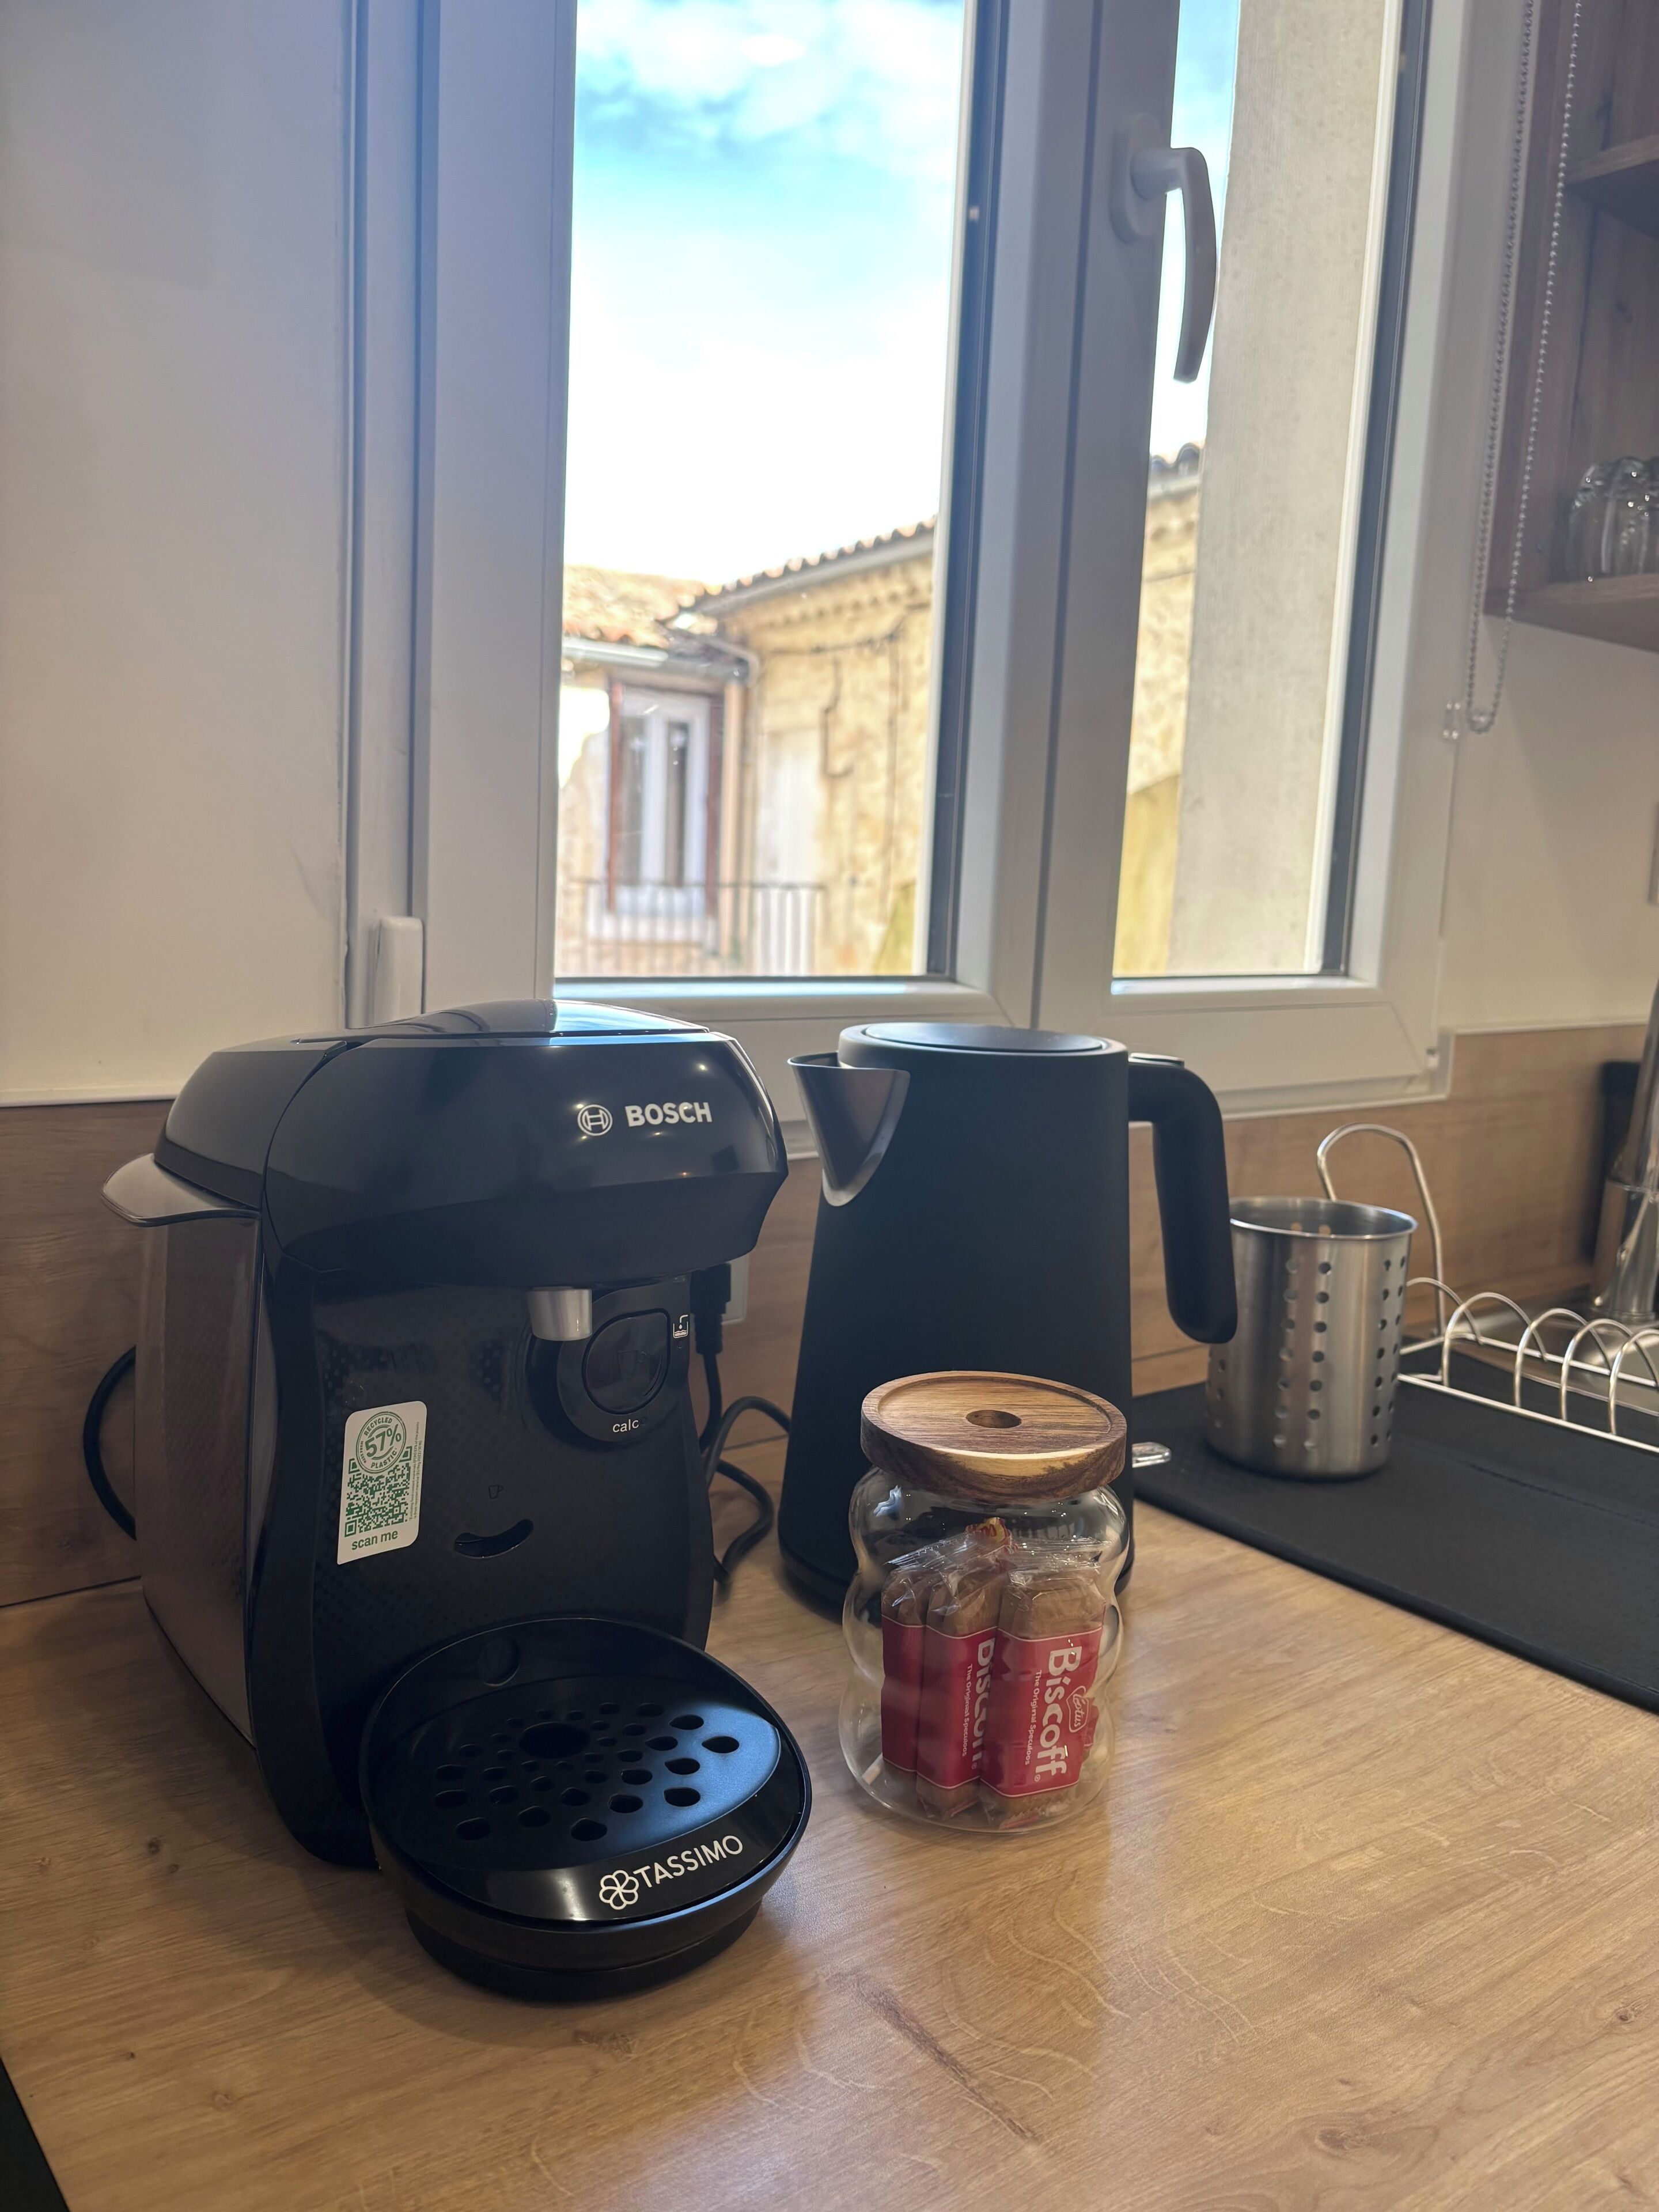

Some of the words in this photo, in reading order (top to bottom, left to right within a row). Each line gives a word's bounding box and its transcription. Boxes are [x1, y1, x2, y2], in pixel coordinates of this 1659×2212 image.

[624, 1102, 712, 1127] BOSCH
[364, 1417, 392, 1436] RECYCLED
[365, 1424, 402, 1457] 57%
[612, 1419, 639, 1433] calc
[351, 1535, 377, 1550] scan
[381, 1530, 398, 1543] me
[964, 1681, 972, 1717] Original
[1031, 1688, 1040, 1722] Original
[962, 1718, 970, 1757] Speculoos
[1025, 1724, 1036, 1765] Speculoos
[632, 1835, 743, 1888] TASSIMO
